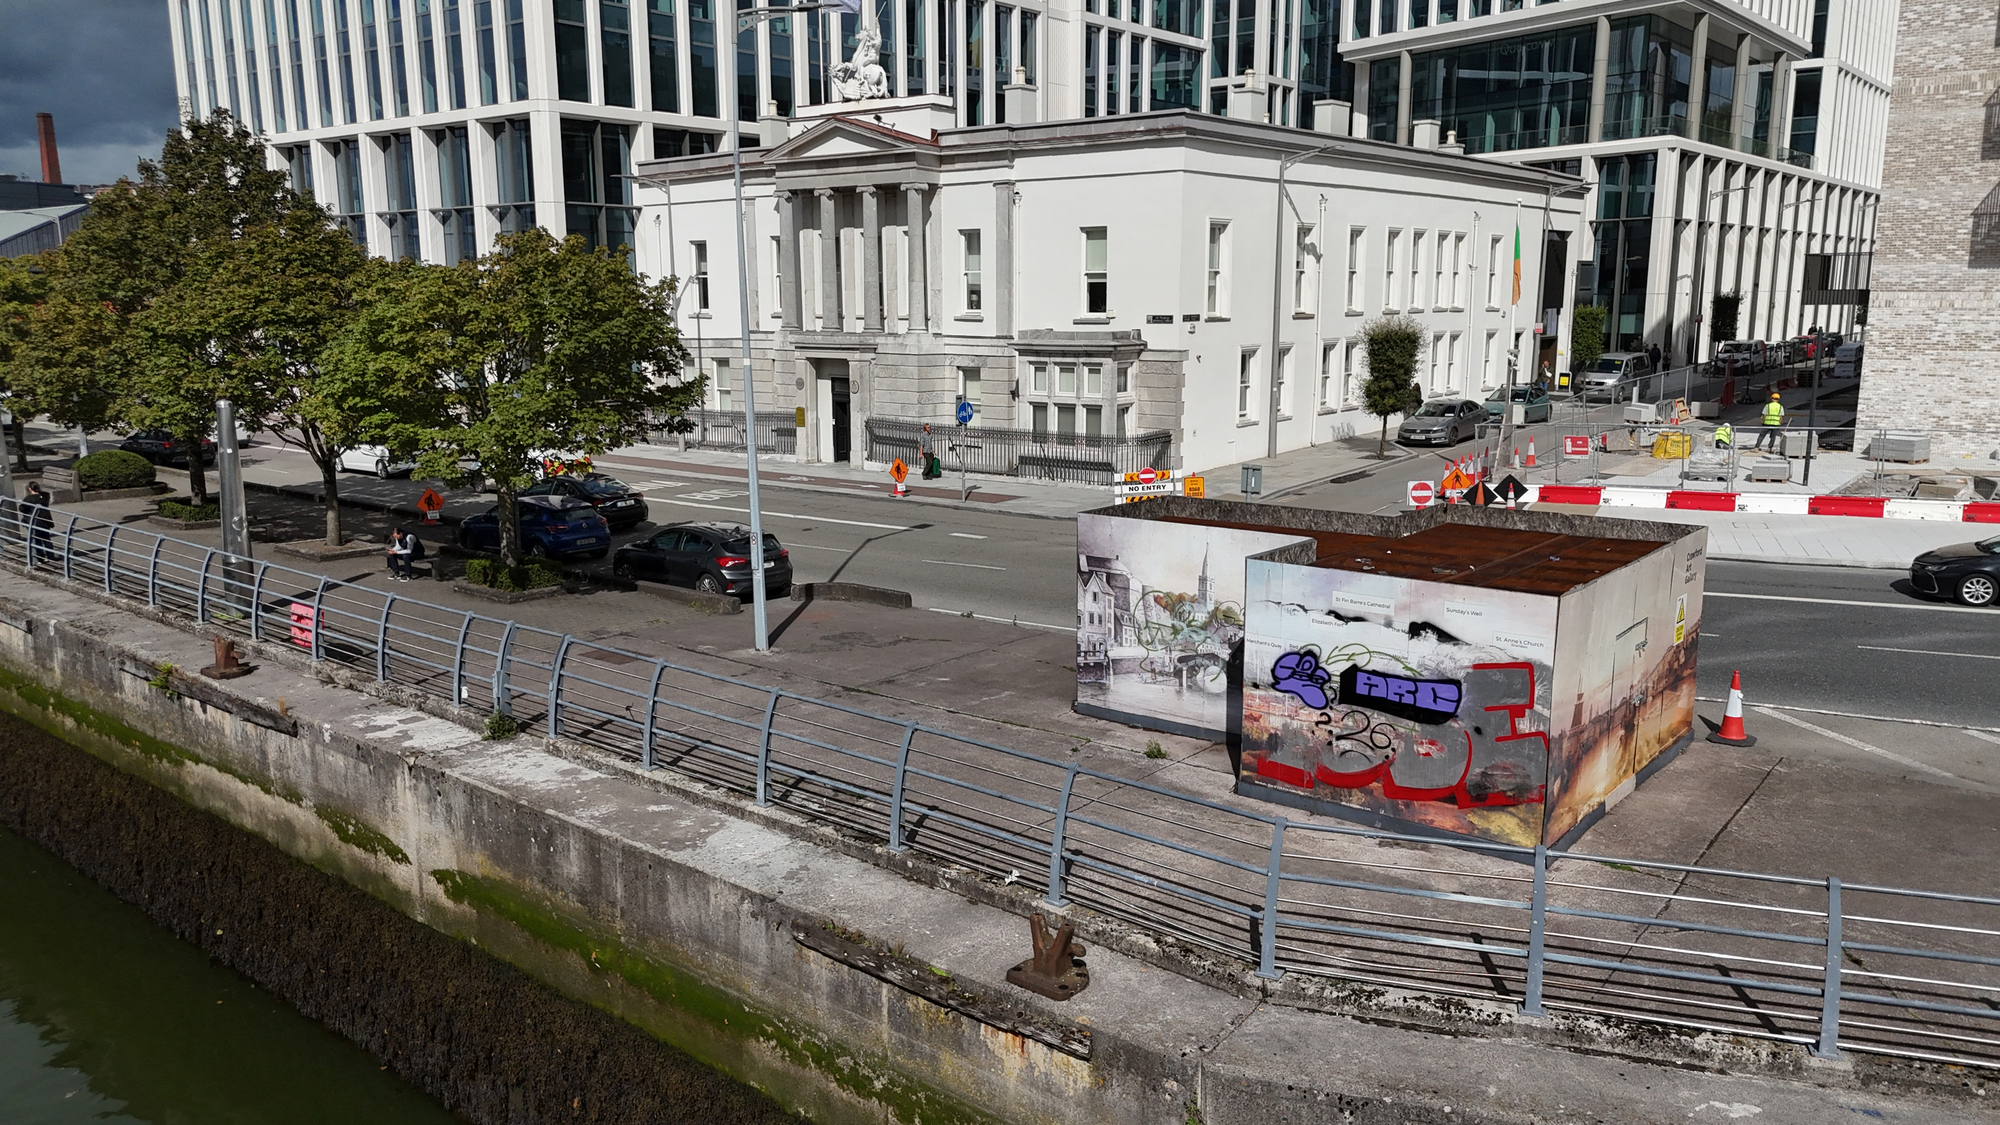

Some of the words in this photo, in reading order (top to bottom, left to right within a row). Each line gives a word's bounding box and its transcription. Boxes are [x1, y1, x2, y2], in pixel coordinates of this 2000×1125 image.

[1500, 40, 1556, 55] Quacomm
[1686, 546, 1703, 562] Crawford
[1684, 571, 1697, 585] Gallery
[1350, 598, 1366, 606] Barre's
[1367, 601, 1391, 609] Cathedral
[1446, 607, 1469, 616] Sunday's
[1312, 618, 1333, 626] Elizabeth
[1247, 638, 1270, 647] Merchant's
[1503, 637, 1522, 645] Anne's
[1523, 640, 1545, 648] Church
